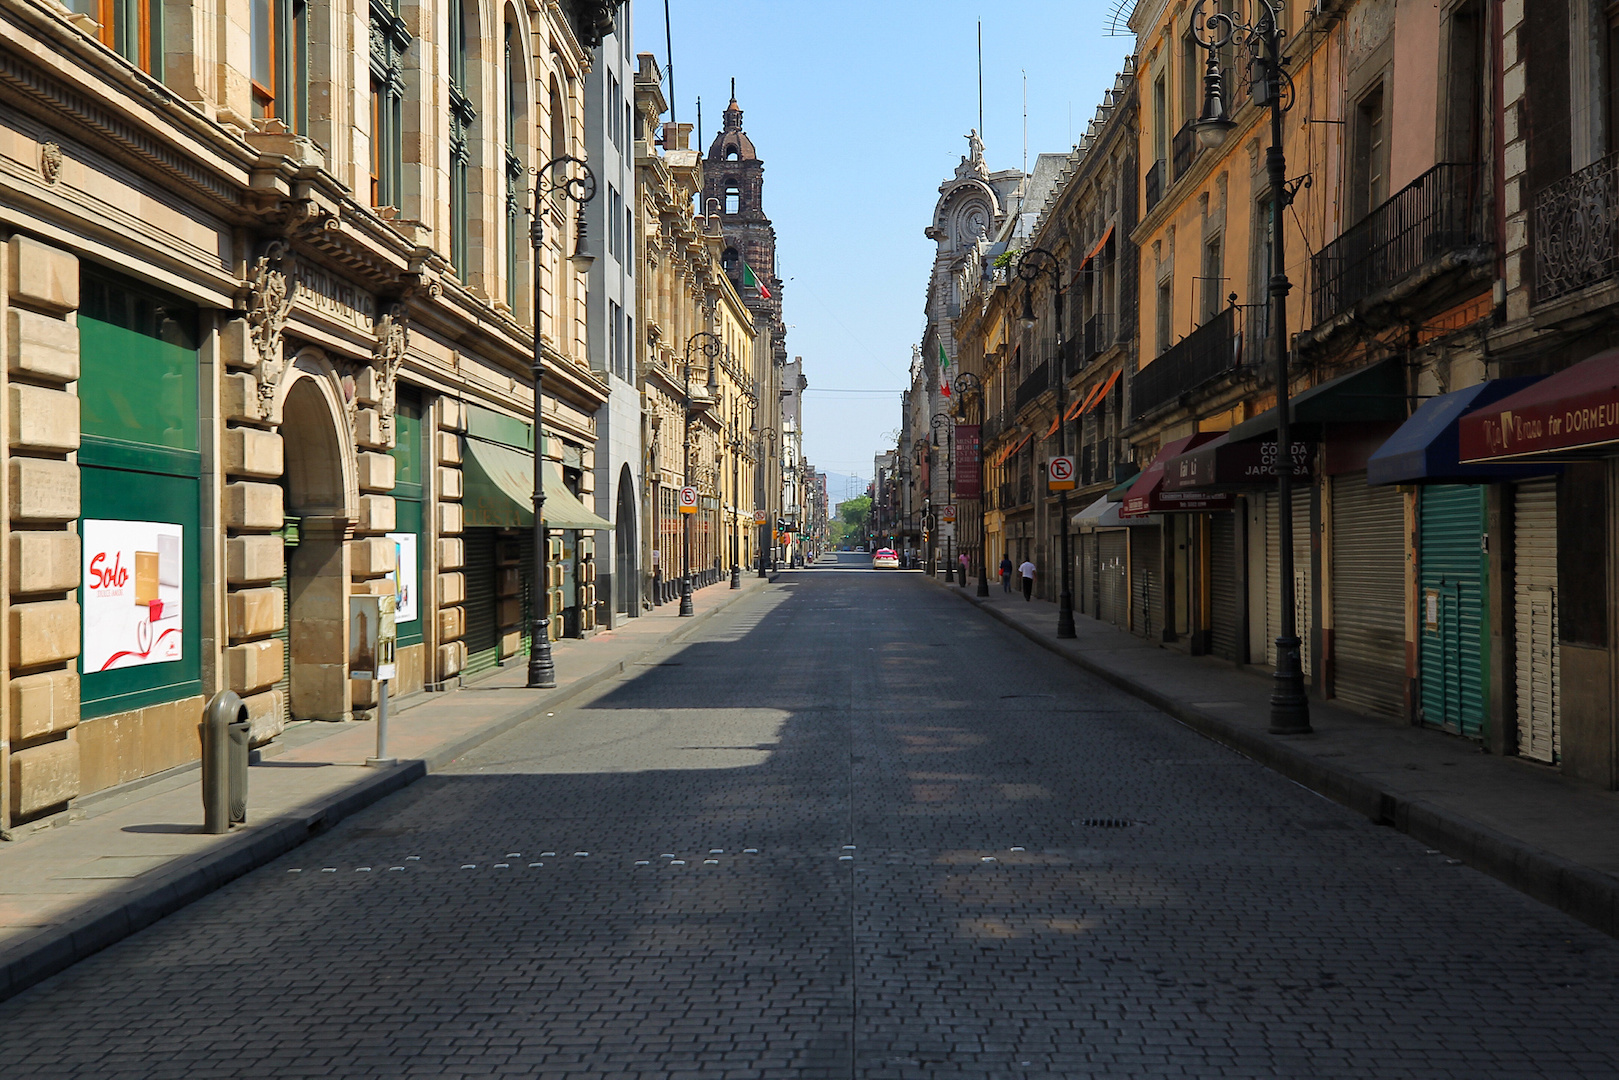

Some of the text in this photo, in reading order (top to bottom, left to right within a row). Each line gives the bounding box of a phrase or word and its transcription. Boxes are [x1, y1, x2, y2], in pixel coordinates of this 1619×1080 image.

[1548, 414, 1563, 437] for
[1260, 445, 1308, 455] CODA
[1245, 466, 1309, 476] JAPOSA
[464, 509, 522, 526] CUESTA
[90, 551, 129, 590] Solo
